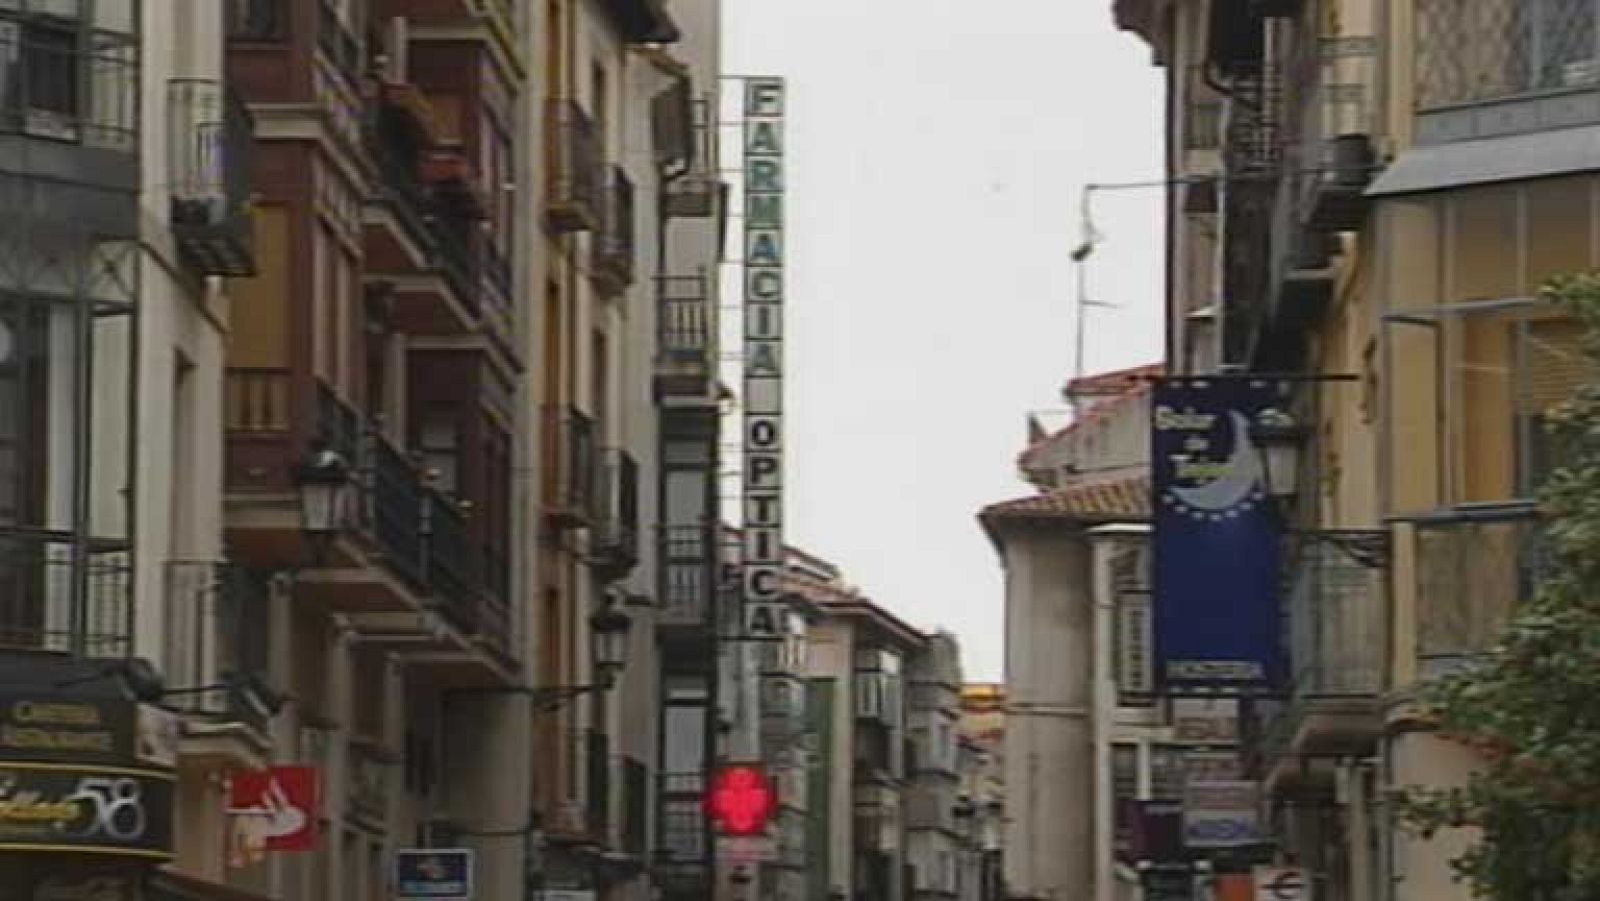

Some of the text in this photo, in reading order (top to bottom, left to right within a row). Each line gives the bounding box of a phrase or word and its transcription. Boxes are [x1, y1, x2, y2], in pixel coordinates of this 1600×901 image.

[751, 83, 782, 633] FARMACIA OPTICA
[54, 778, 145, 840] 58
